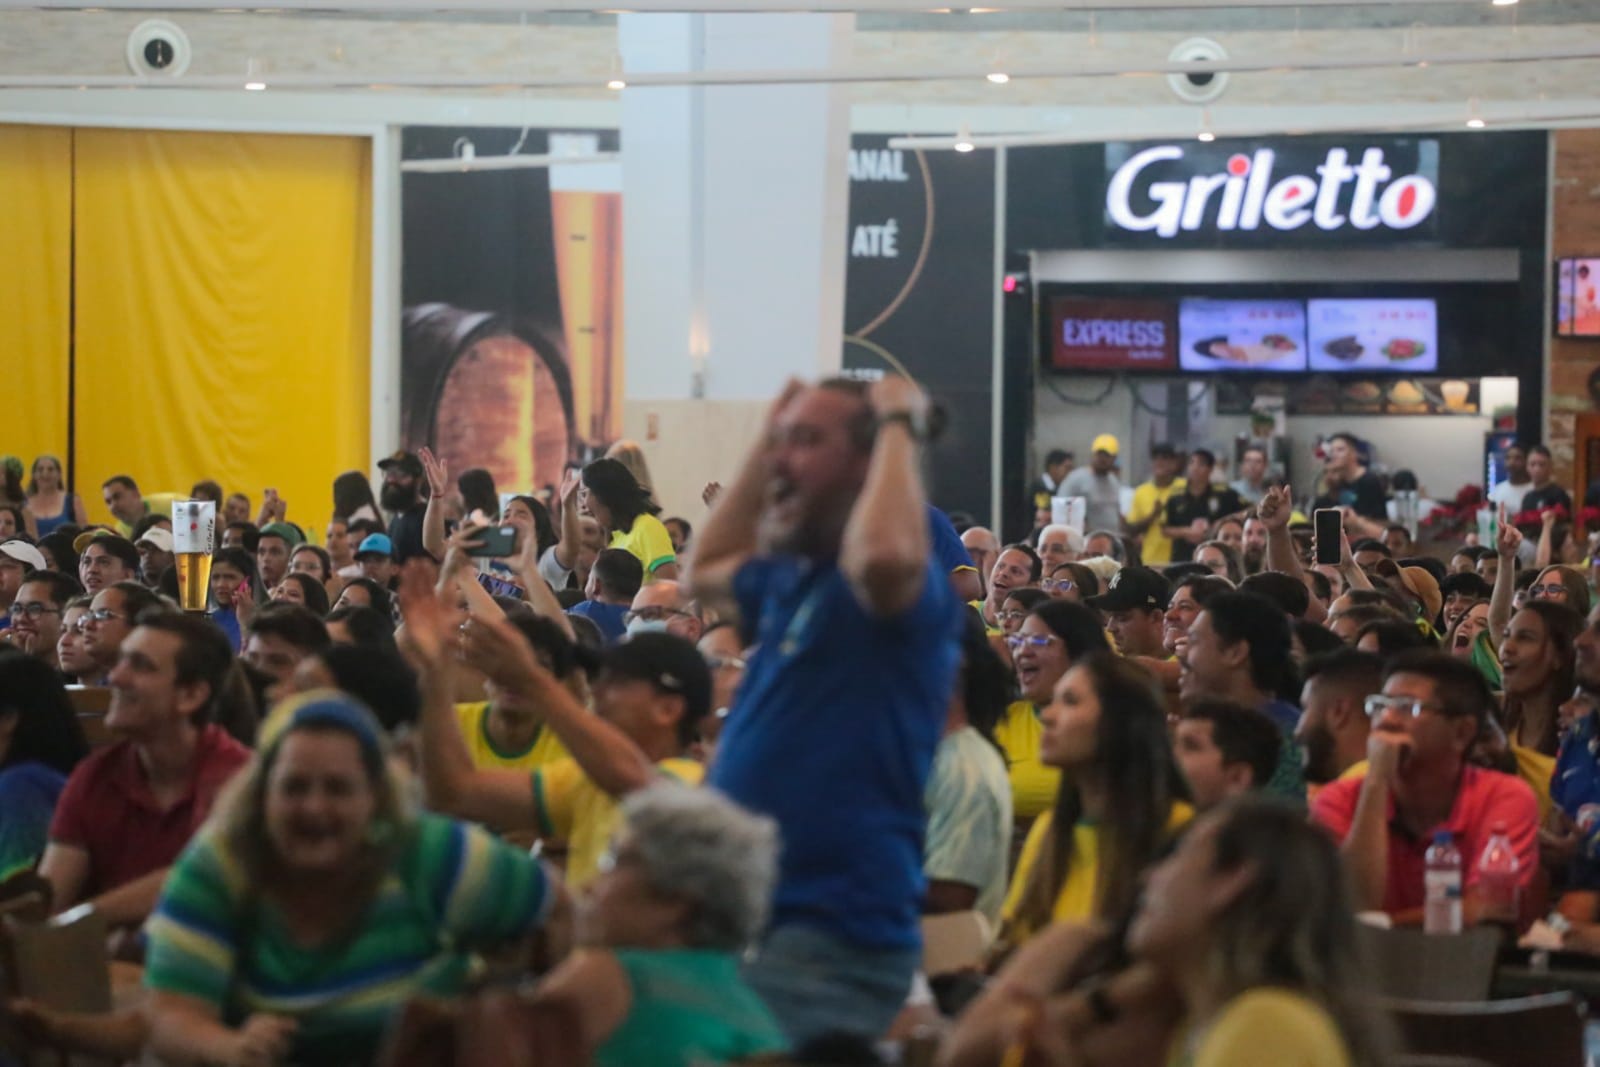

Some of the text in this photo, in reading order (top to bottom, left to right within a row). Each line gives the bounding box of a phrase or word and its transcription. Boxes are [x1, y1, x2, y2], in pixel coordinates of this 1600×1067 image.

[1106, 146, 1436, 237] Griletto
[852, 218, 899, 257] ATÉ
[1063, 319, 1165, 346] EXPRESS
